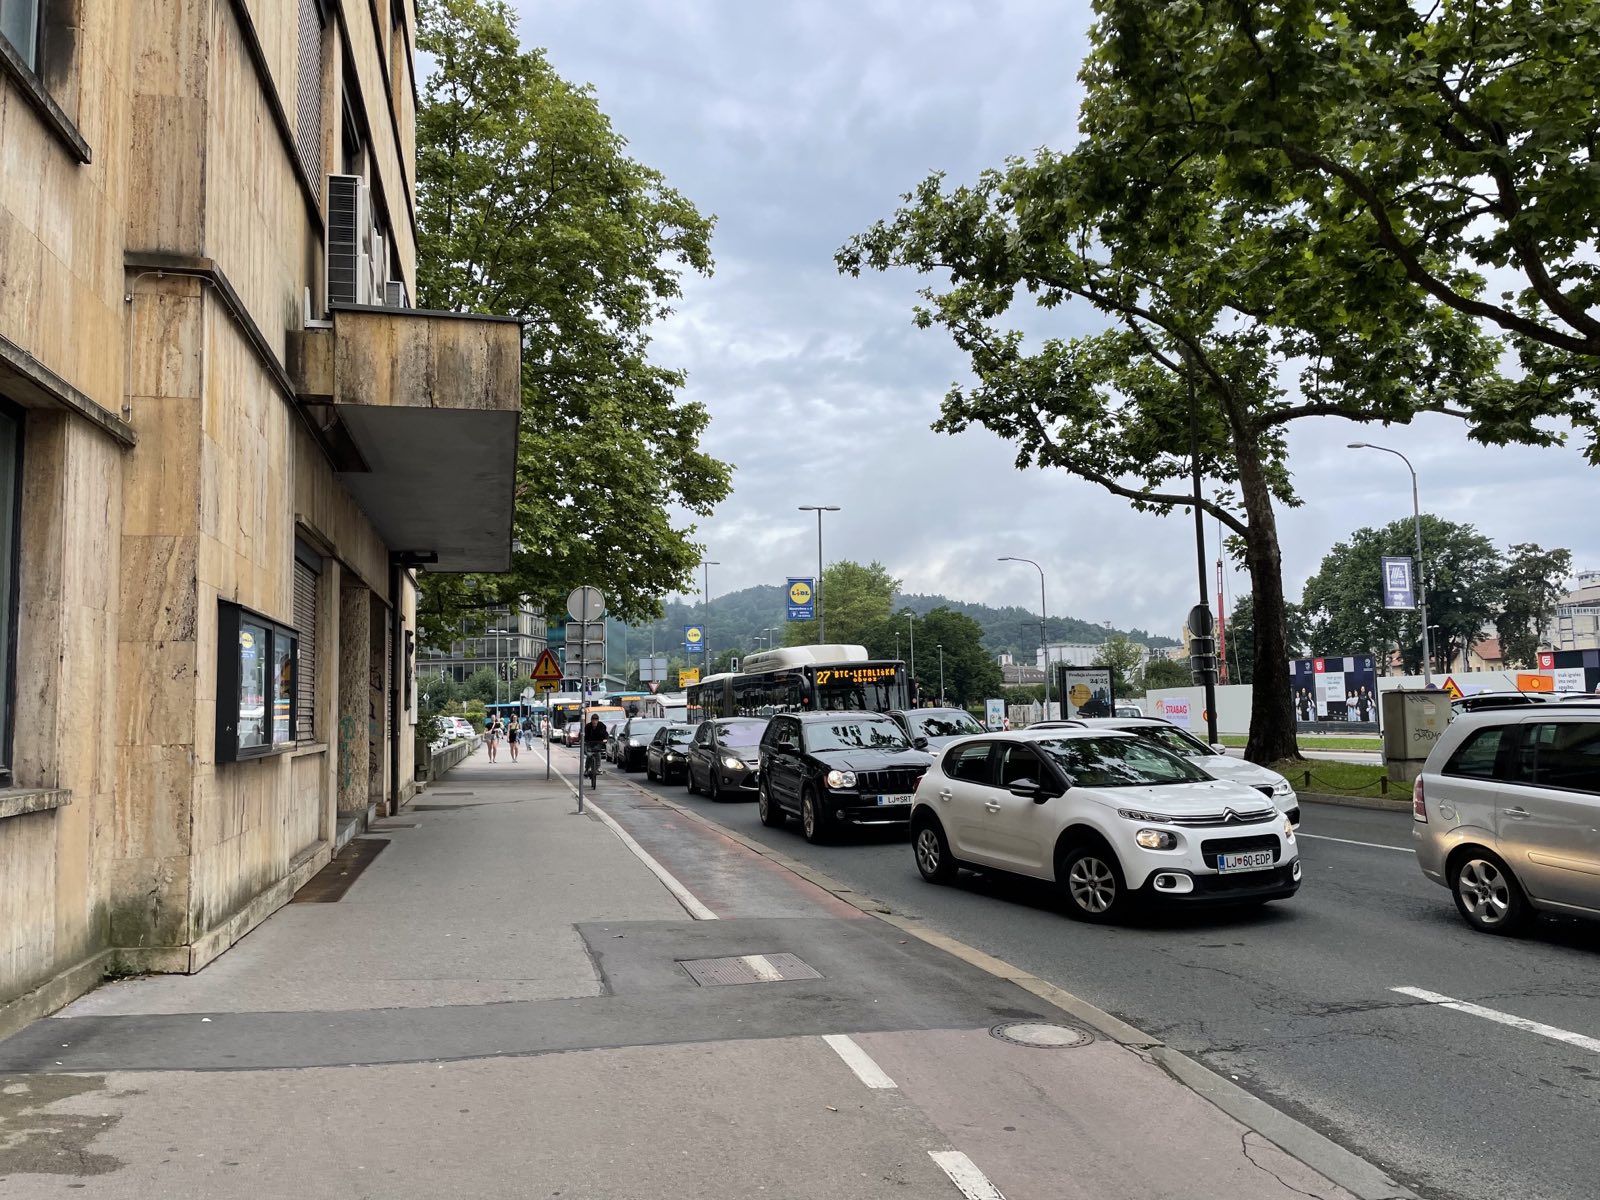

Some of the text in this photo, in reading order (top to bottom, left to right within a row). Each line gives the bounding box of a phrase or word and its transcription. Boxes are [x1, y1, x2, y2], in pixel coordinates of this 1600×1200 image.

[816, 671, 831, 685] 27
[1165, 705, 1188, 714] STRABAG
[887, 795, 912, 804] LJ SRT
[1226, 853, 1271, 868] LJ 60-EDP
